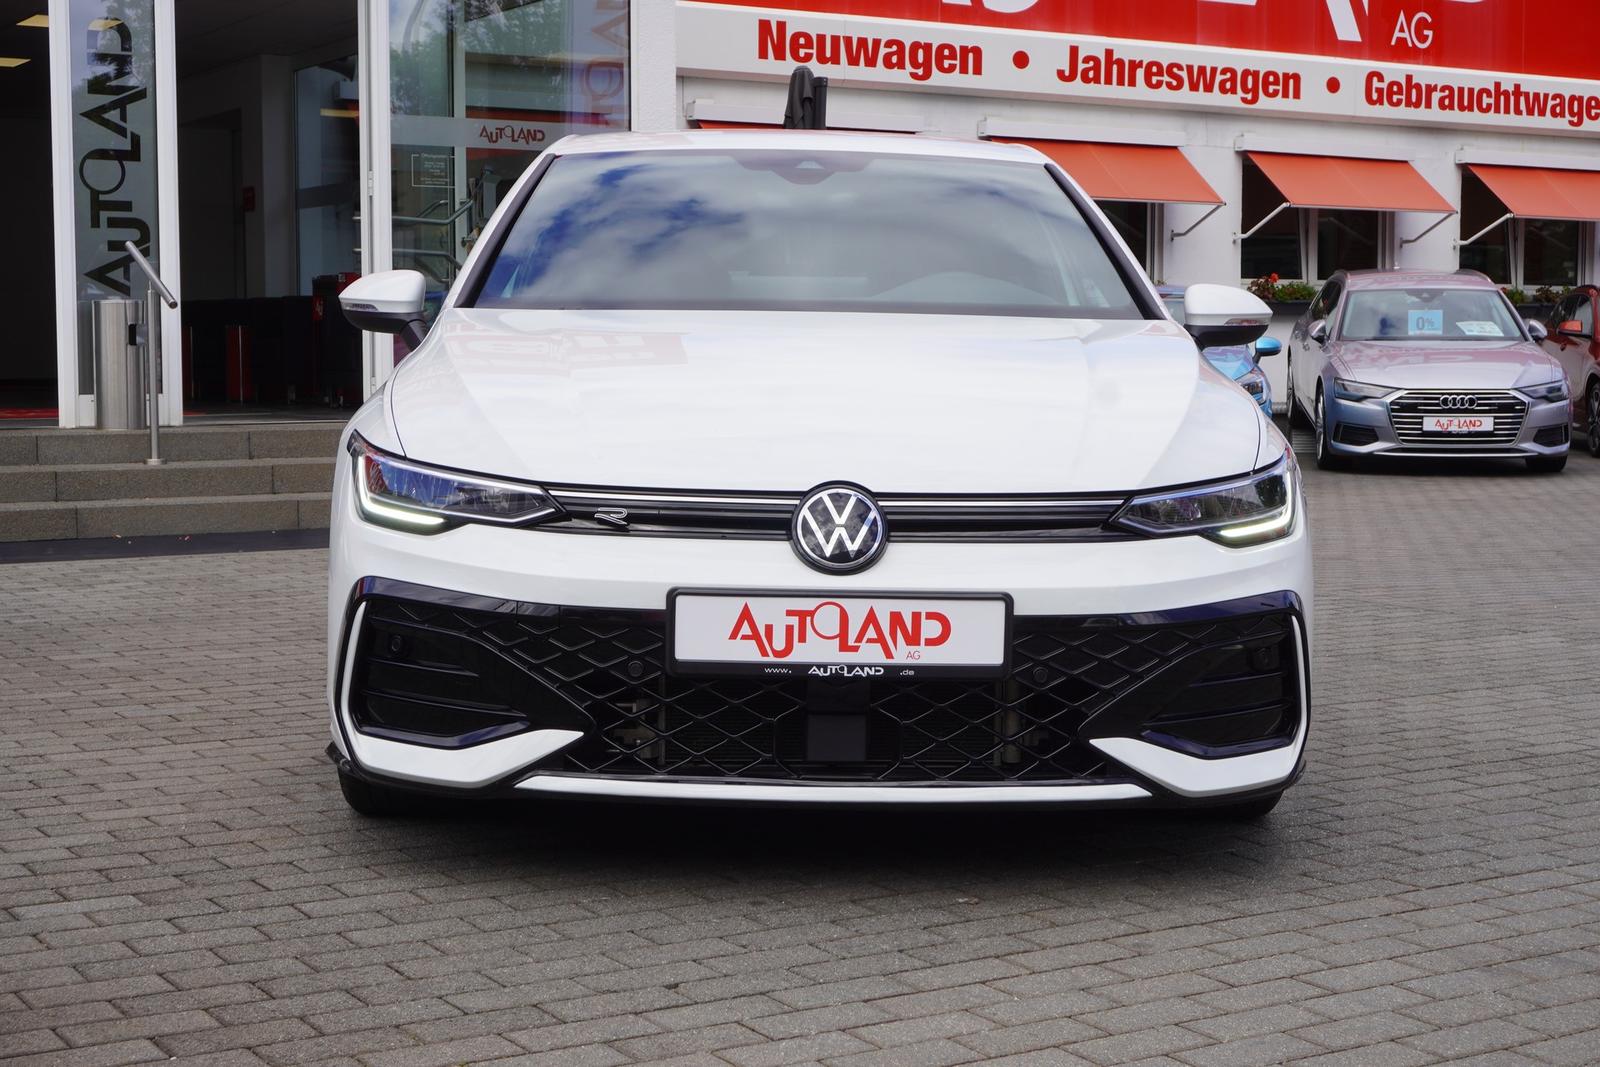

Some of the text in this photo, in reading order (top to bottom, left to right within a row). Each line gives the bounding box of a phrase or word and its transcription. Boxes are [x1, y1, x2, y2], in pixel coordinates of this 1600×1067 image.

[1391, 10, 1433, 49] AG
[757, 19, 983, 81] Neuwagen
[1056, 45, 1302, 105] Jahreswagen
[480, 125, 545, 144] AUTOLAND
[79, 17, 151, 297] AUTOLAND
[1416, 316, 1435, 331] 0%
[1435, 419, 1483, 431] AUTLAND
[728, 601, 952, 659] AUTOLAND
[905, 650, 921, 660] AG
[808, 664, 884, 677] AUTOLAND
